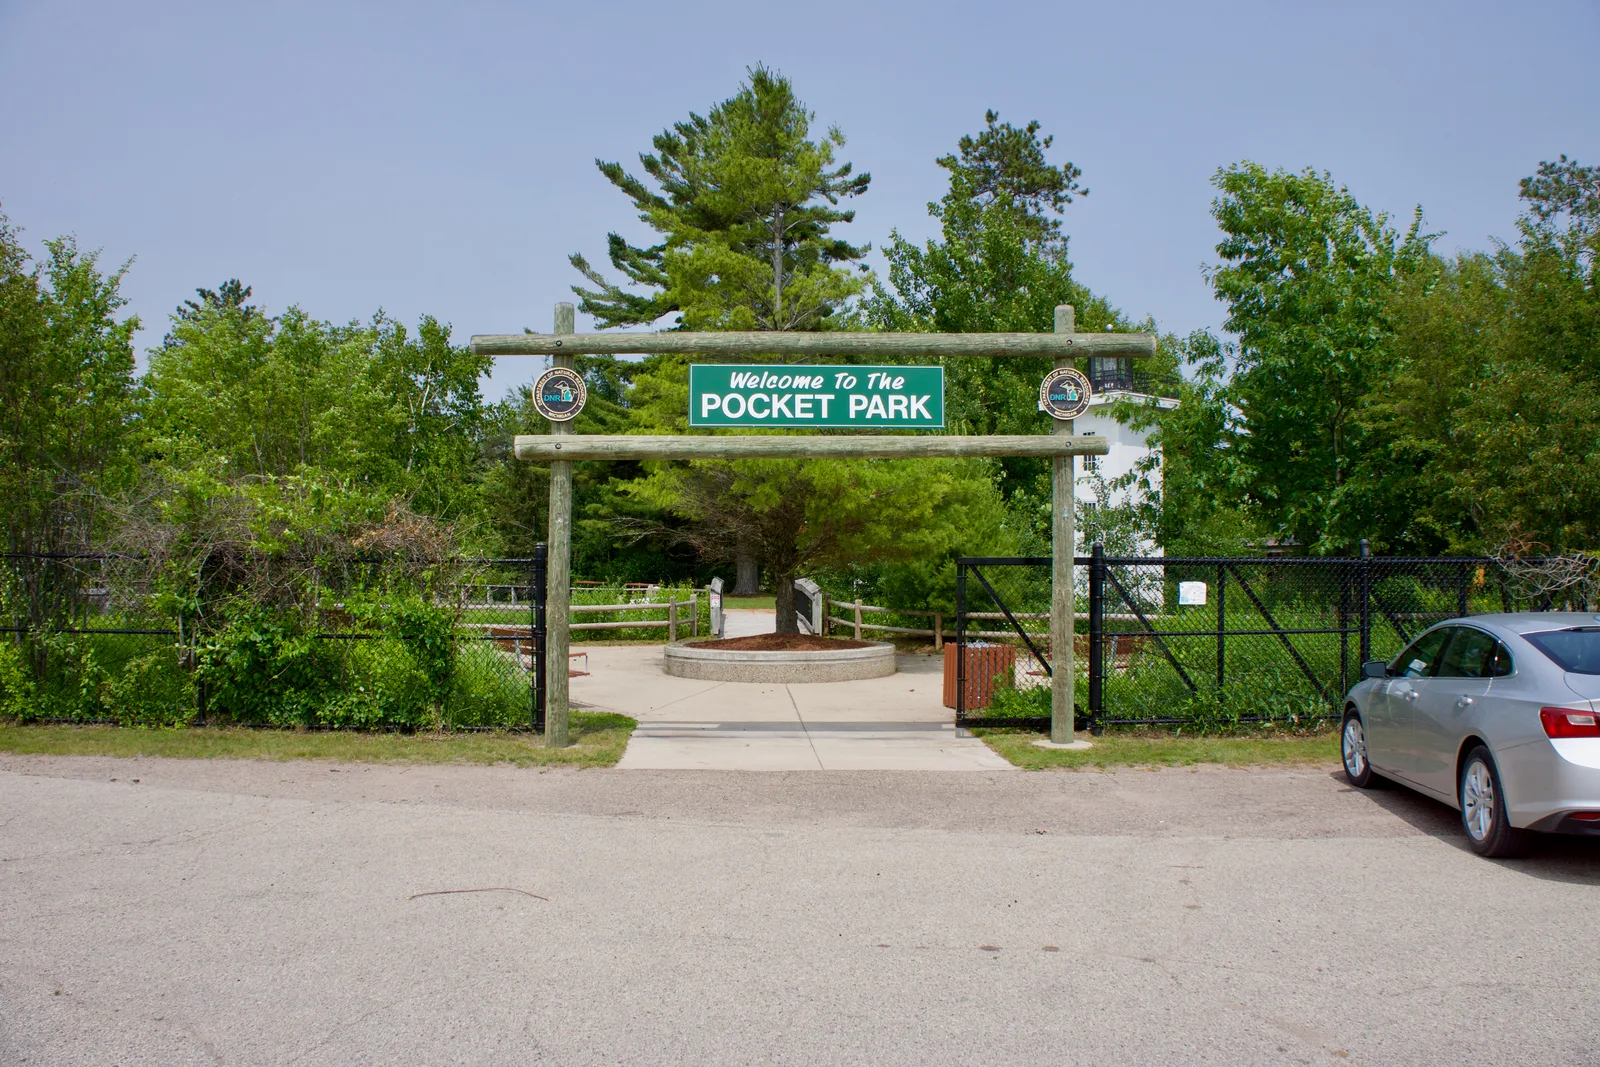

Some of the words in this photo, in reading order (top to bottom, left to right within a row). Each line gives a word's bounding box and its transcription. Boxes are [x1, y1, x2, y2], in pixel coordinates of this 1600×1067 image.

[536, 376, 548, 406] DEPARTMENT
[554, 370, 575, 379] NATURAL
[574, 377, 585, 406] RESOURCES
[729, 371, 824, 390] Welcome
[834, 372, 857, 390] To
[867, 372, 905, 390] The
[1042, 376, 1053, 405] DEPARTMENT
[1059, 370, 1080, 379] NATURAL
[1080, 377, 1090, 405] RESOURCES
[701, 393, 835, 419] POCKET
[849, 394, 932, 420] PARK
